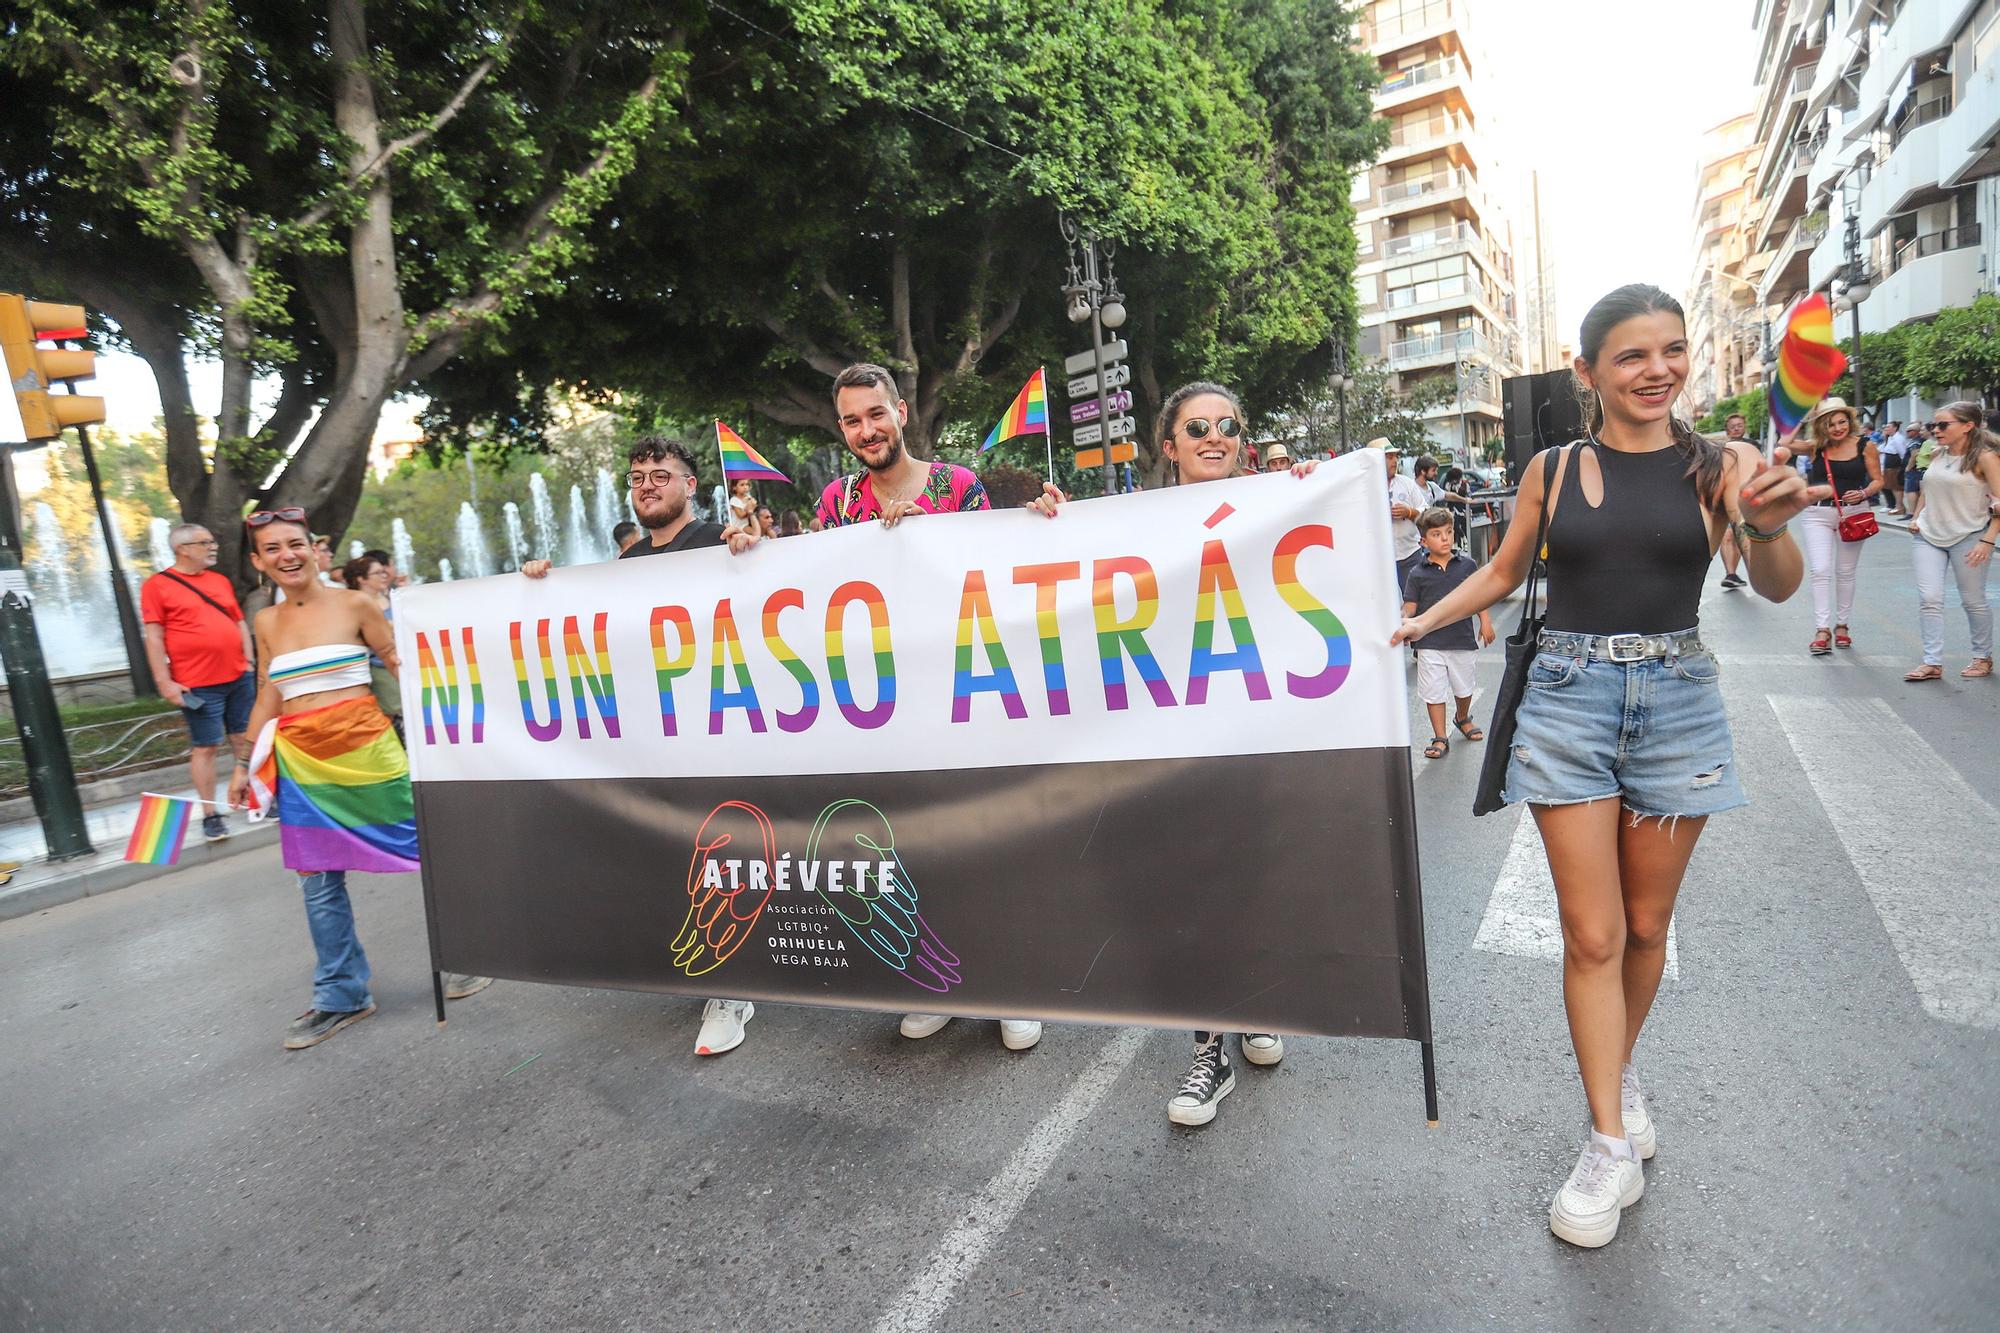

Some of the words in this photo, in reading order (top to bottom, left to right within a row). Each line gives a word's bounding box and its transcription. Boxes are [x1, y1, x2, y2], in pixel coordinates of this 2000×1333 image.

[416, 627, 485, 745] NI
[509, 612, 621, 742] UN
[650, 581, 897, 737] PASO
[951, 502, 1352, 724] ATRÁS
[703, 852, 897, 893] ATRÉVETE
[767, 903, 836, 916] Asociación
[777, 921, 830, 934] LGTBIQ+
[768, 937, 846, 951] ORIHUELA
[771, 954, 809, 966] VEGA
[814, 956, 849, 968] BAJA
